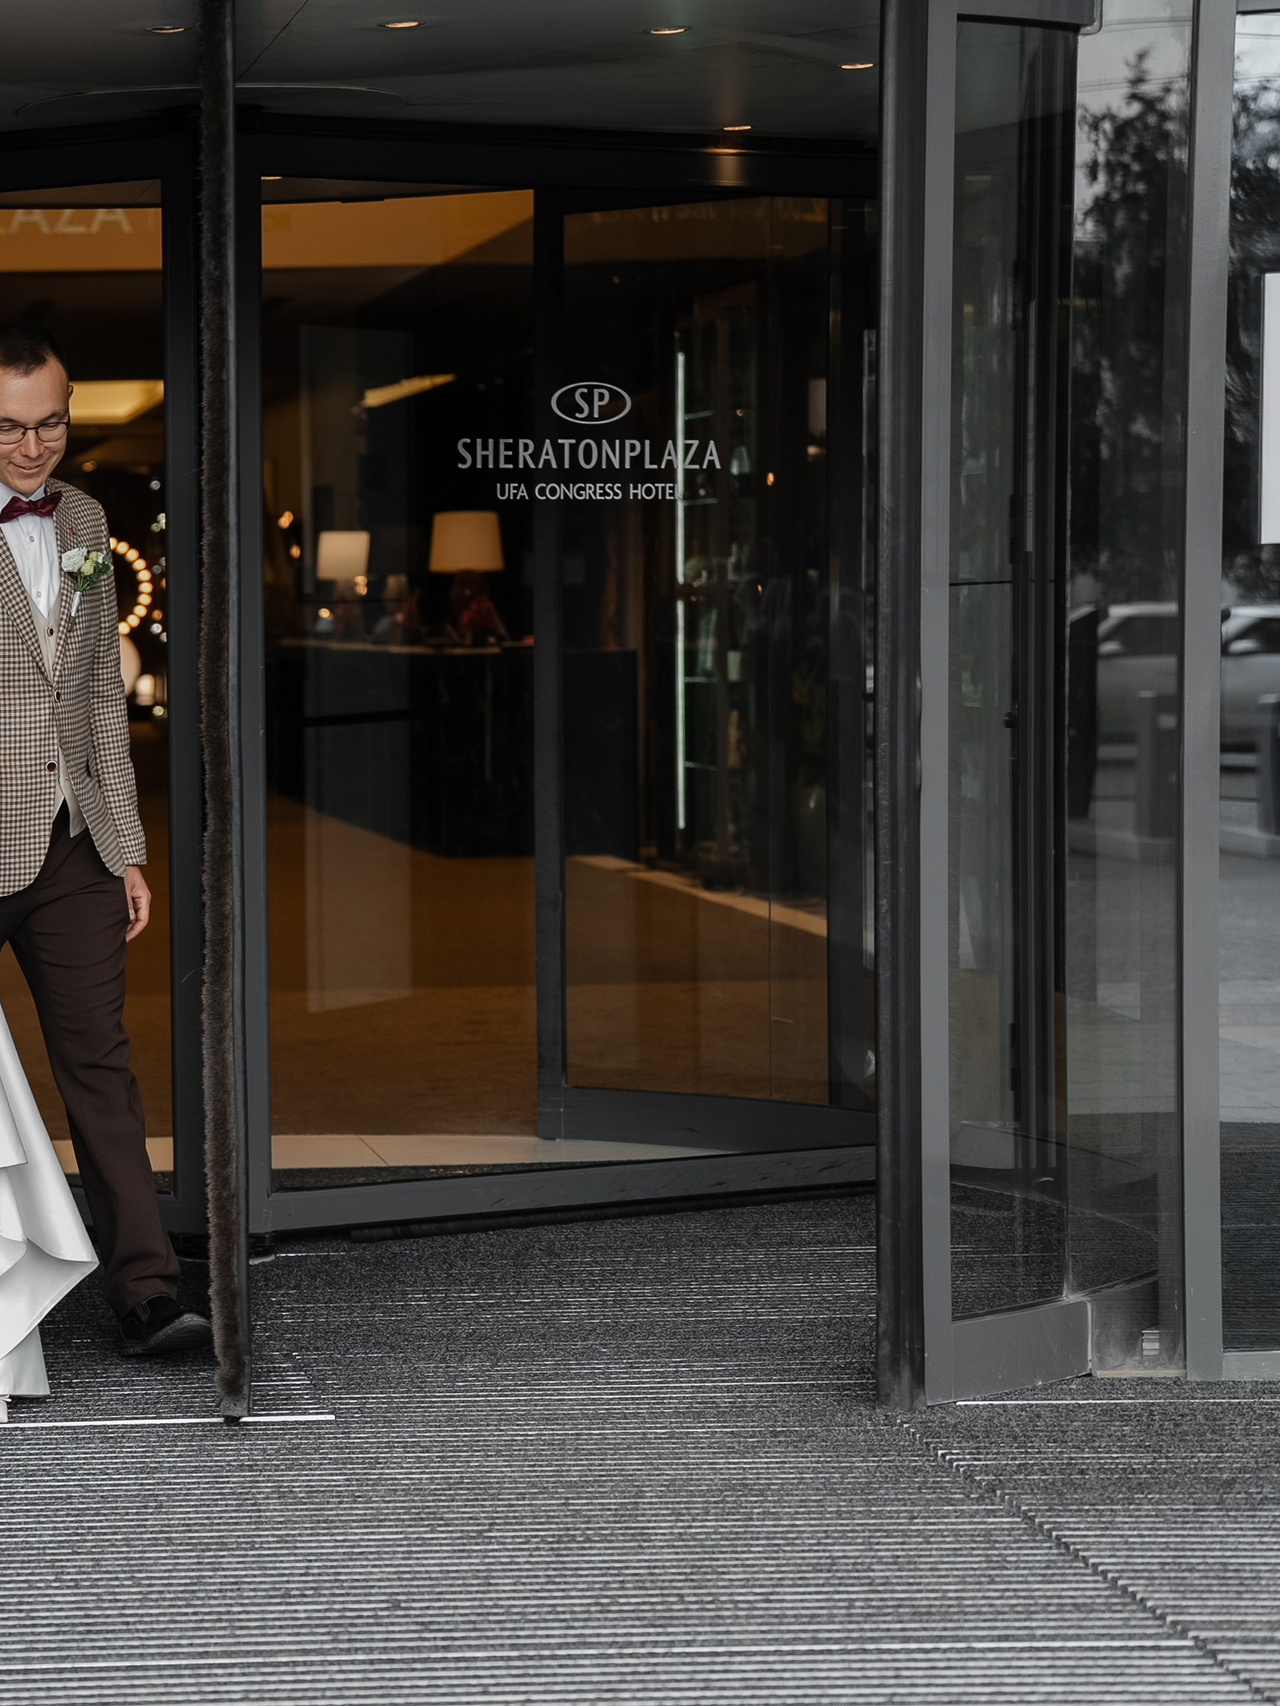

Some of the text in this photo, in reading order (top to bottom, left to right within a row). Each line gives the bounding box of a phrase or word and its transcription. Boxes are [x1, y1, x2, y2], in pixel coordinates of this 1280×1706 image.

[457, 437, 722, 469] SHERATONPLAZA
[496, 483, 529, 500] UFA
[535, 483, 623, 500] CONGRESS
